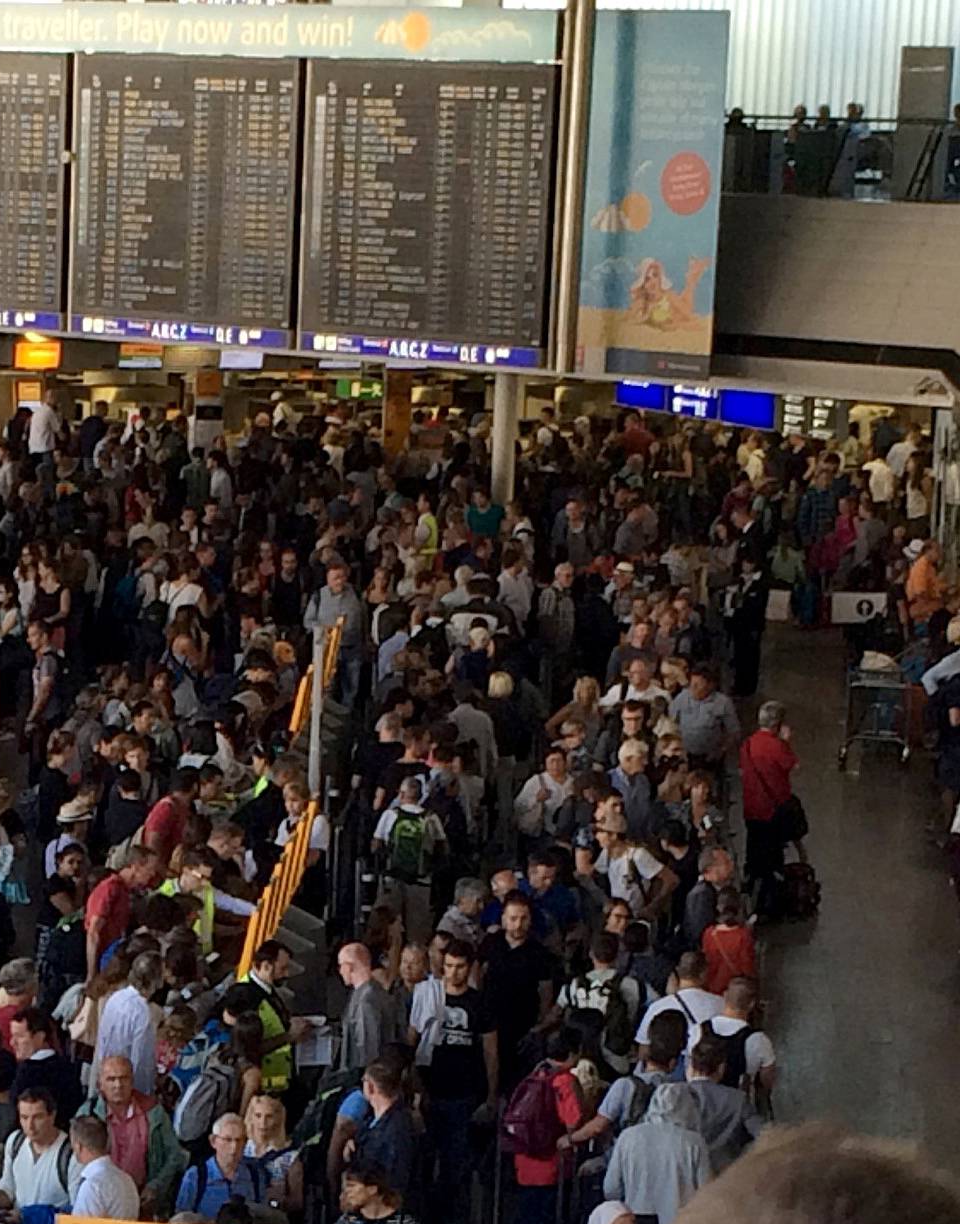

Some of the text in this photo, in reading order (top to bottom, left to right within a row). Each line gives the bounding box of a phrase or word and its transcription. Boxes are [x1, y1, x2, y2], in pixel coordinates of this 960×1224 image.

[3, 9, 107, 42] traveller.
[116, 12, 170, 50] Play
[178, 18, 232, 45] now
[240, 14, 288, 46] and
[297, 15, 354, 46] win!
